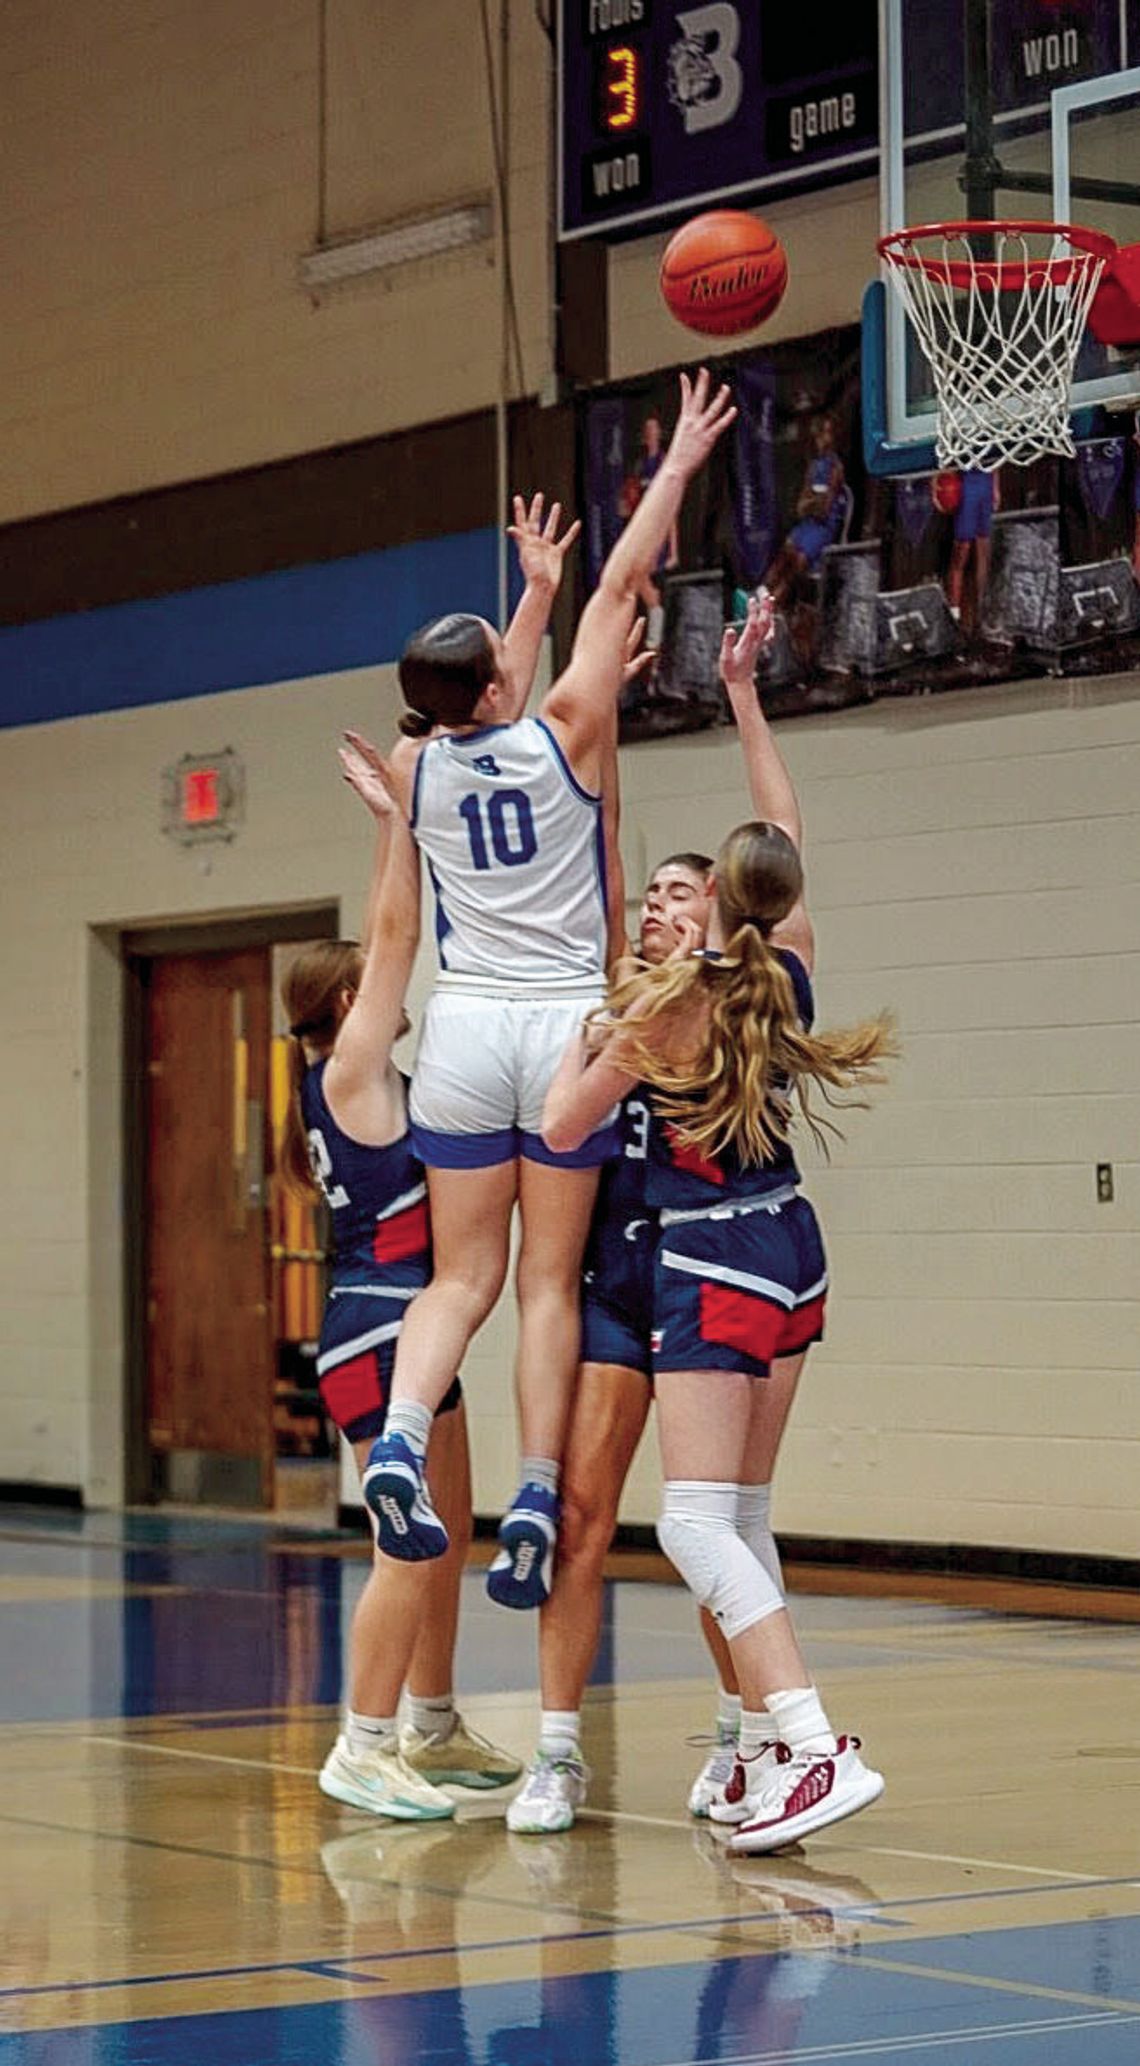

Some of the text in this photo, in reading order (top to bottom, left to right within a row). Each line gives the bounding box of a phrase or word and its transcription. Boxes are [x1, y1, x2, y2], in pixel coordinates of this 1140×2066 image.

[1023, 28, 1079, 77] won
[608, 47, 637, 128] 3
[789, 92, 856, 153] game
[592, 153, 641, 197] won
[459, 788, 538, 871] 10
